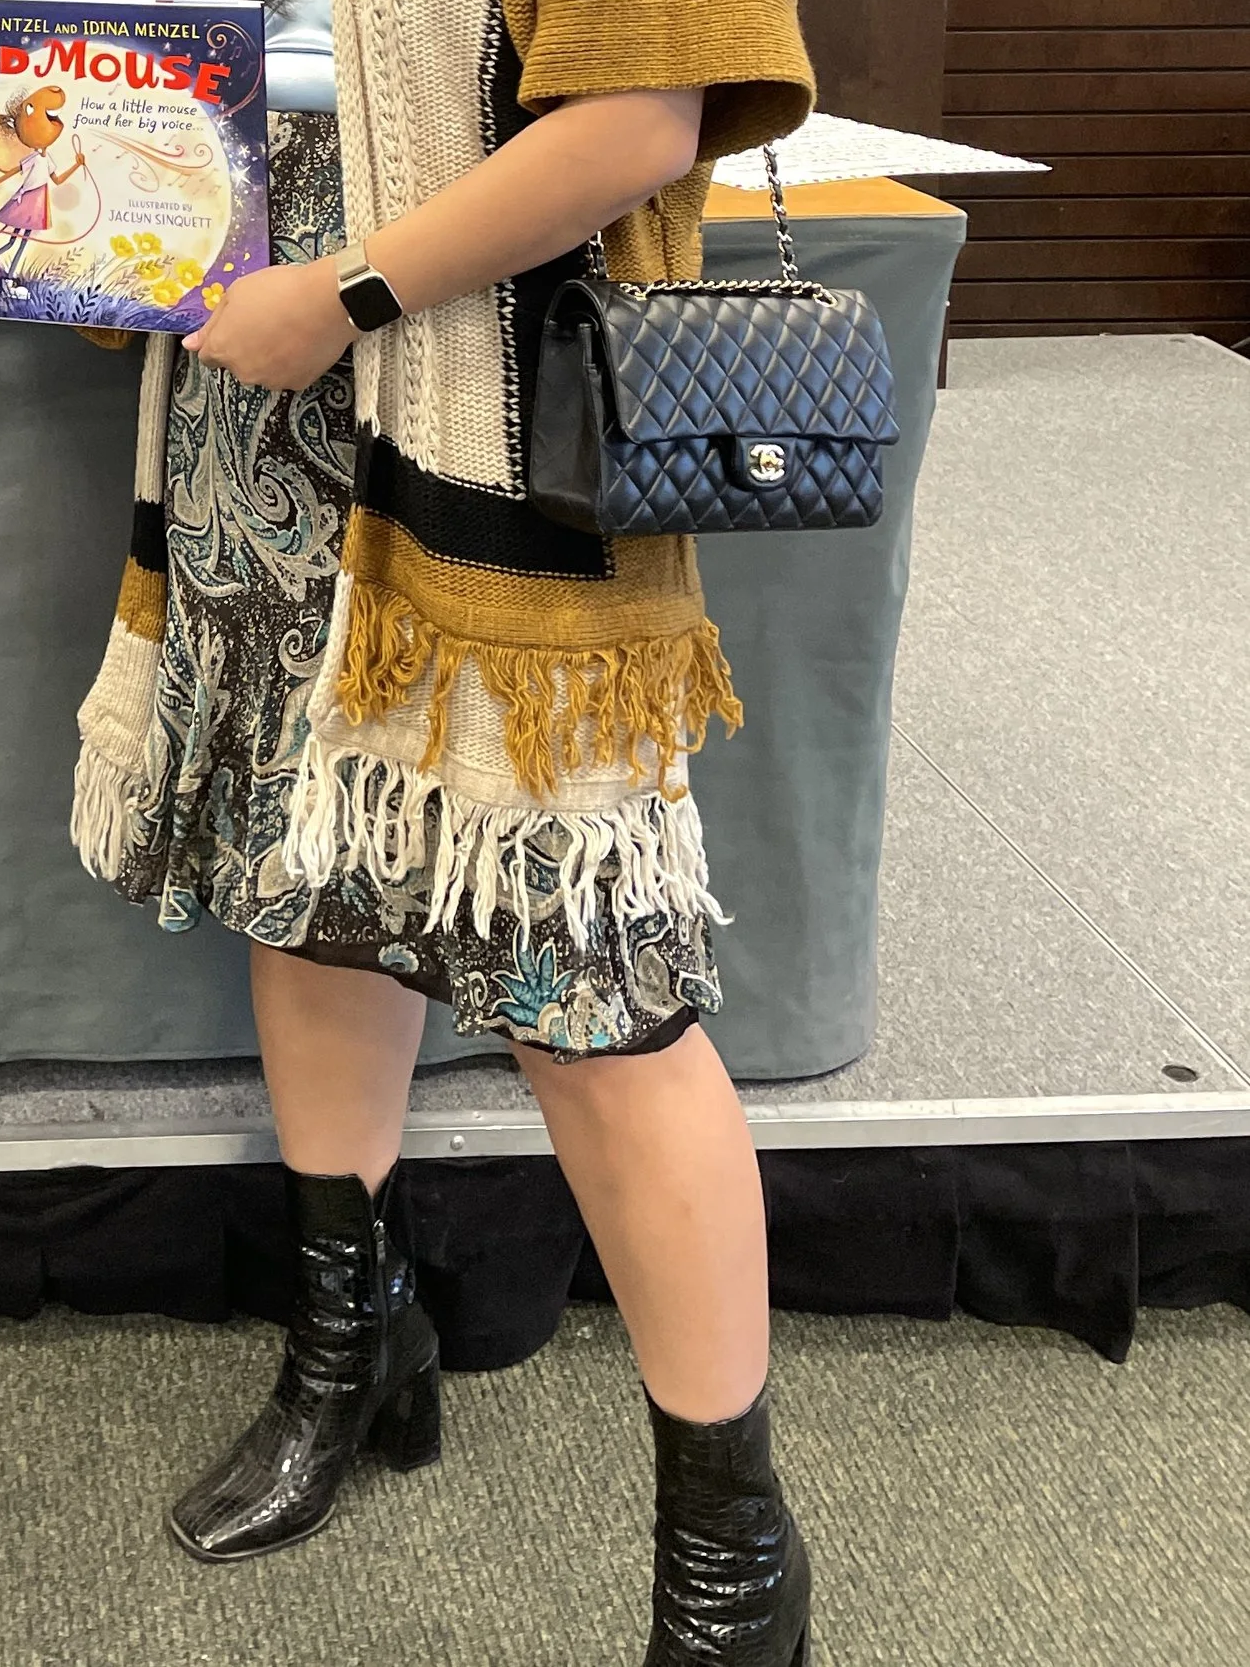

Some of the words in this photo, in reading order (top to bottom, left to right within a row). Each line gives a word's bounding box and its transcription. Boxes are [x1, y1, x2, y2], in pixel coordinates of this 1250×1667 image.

[54, 23, 78, 34] AND
[83, 20, 129, 37] IDINA
[134, 22, 200, 39] MENZEL
[34, 38, 231, 105] MOUSE
[81, 97, 105, 111] How
[109, 102, 116, 111] a
[122, 98, 153, 114] little
[157, 105, 197, 116] mouse
[72, 114, 111, 130] found
[115, 114, 133, 127] her
[139, 117, 157, 133] big
[128, 199, 180, 211] ILLUSTRATED
[108, 210, 151, 224] JACLYN
[155, 213, 212, 229] SINQUETT
